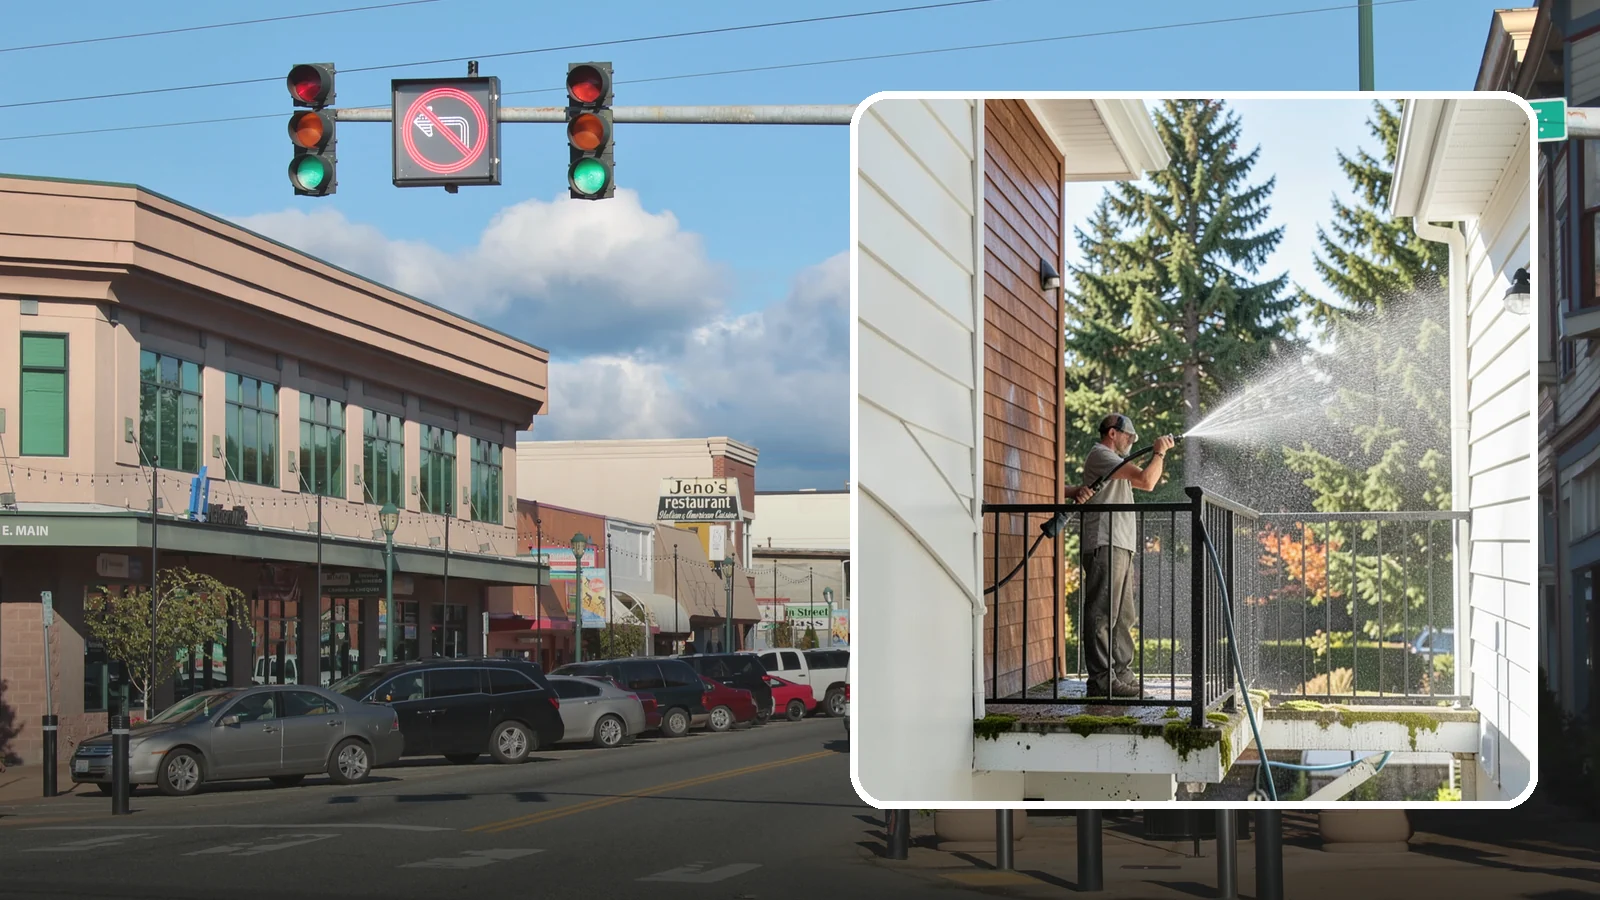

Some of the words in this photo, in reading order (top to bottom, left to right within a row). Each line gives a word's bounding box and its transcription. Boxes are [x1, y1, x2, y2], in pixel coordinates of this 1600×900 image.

[669, 480, 727, 495] Jeno's
[665, 496, 731, 509] restaurant
[686, 509, 714, 519] American
[715, 509, 738, 519] Cuisine
[2, 525, 13, 536] E.
[15, 525, 49, 536] MAIN
[797, 607, 828, 617] Street
